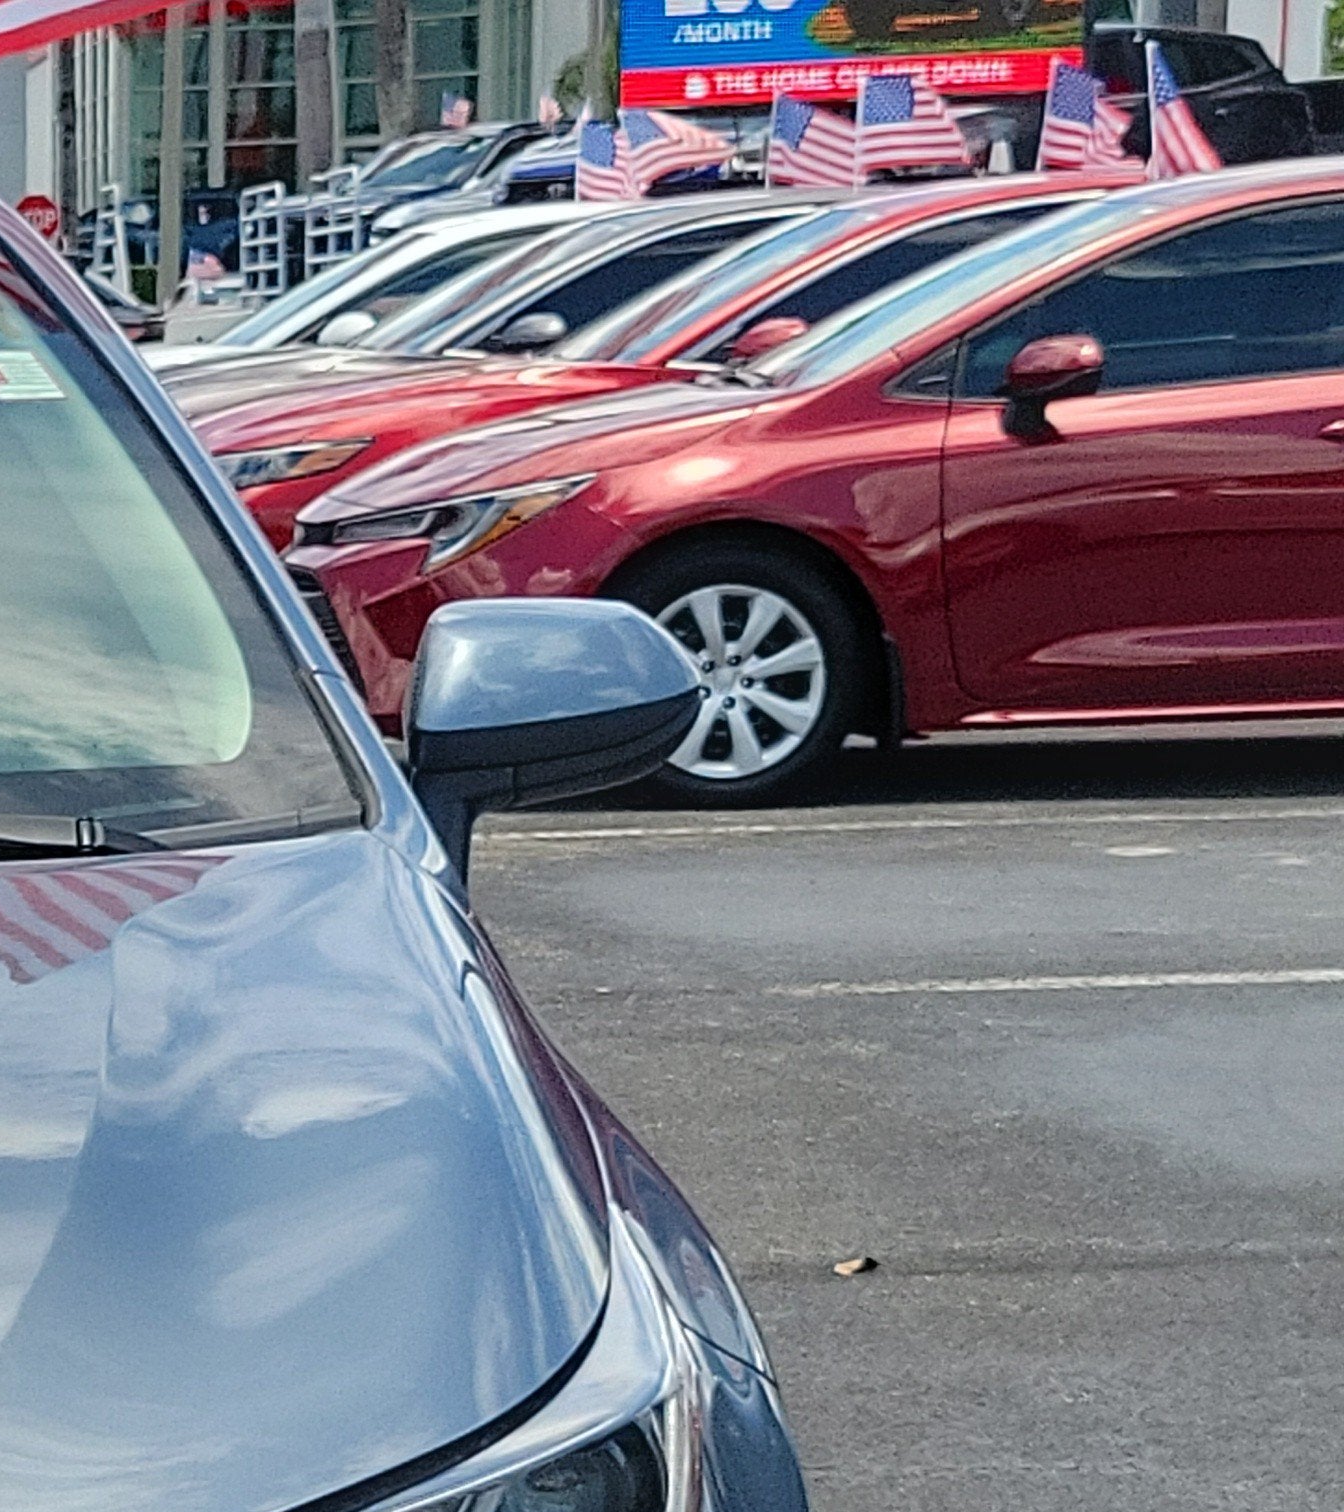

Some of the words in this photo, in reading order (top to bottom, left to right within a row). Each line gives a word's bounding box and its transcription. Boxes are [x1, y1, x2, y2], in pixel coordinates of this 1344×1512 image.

[672, 20, 772, 43] /MONTH
[713, 71, 759, 94] THE
[763, 66, 834, 93] HOME
